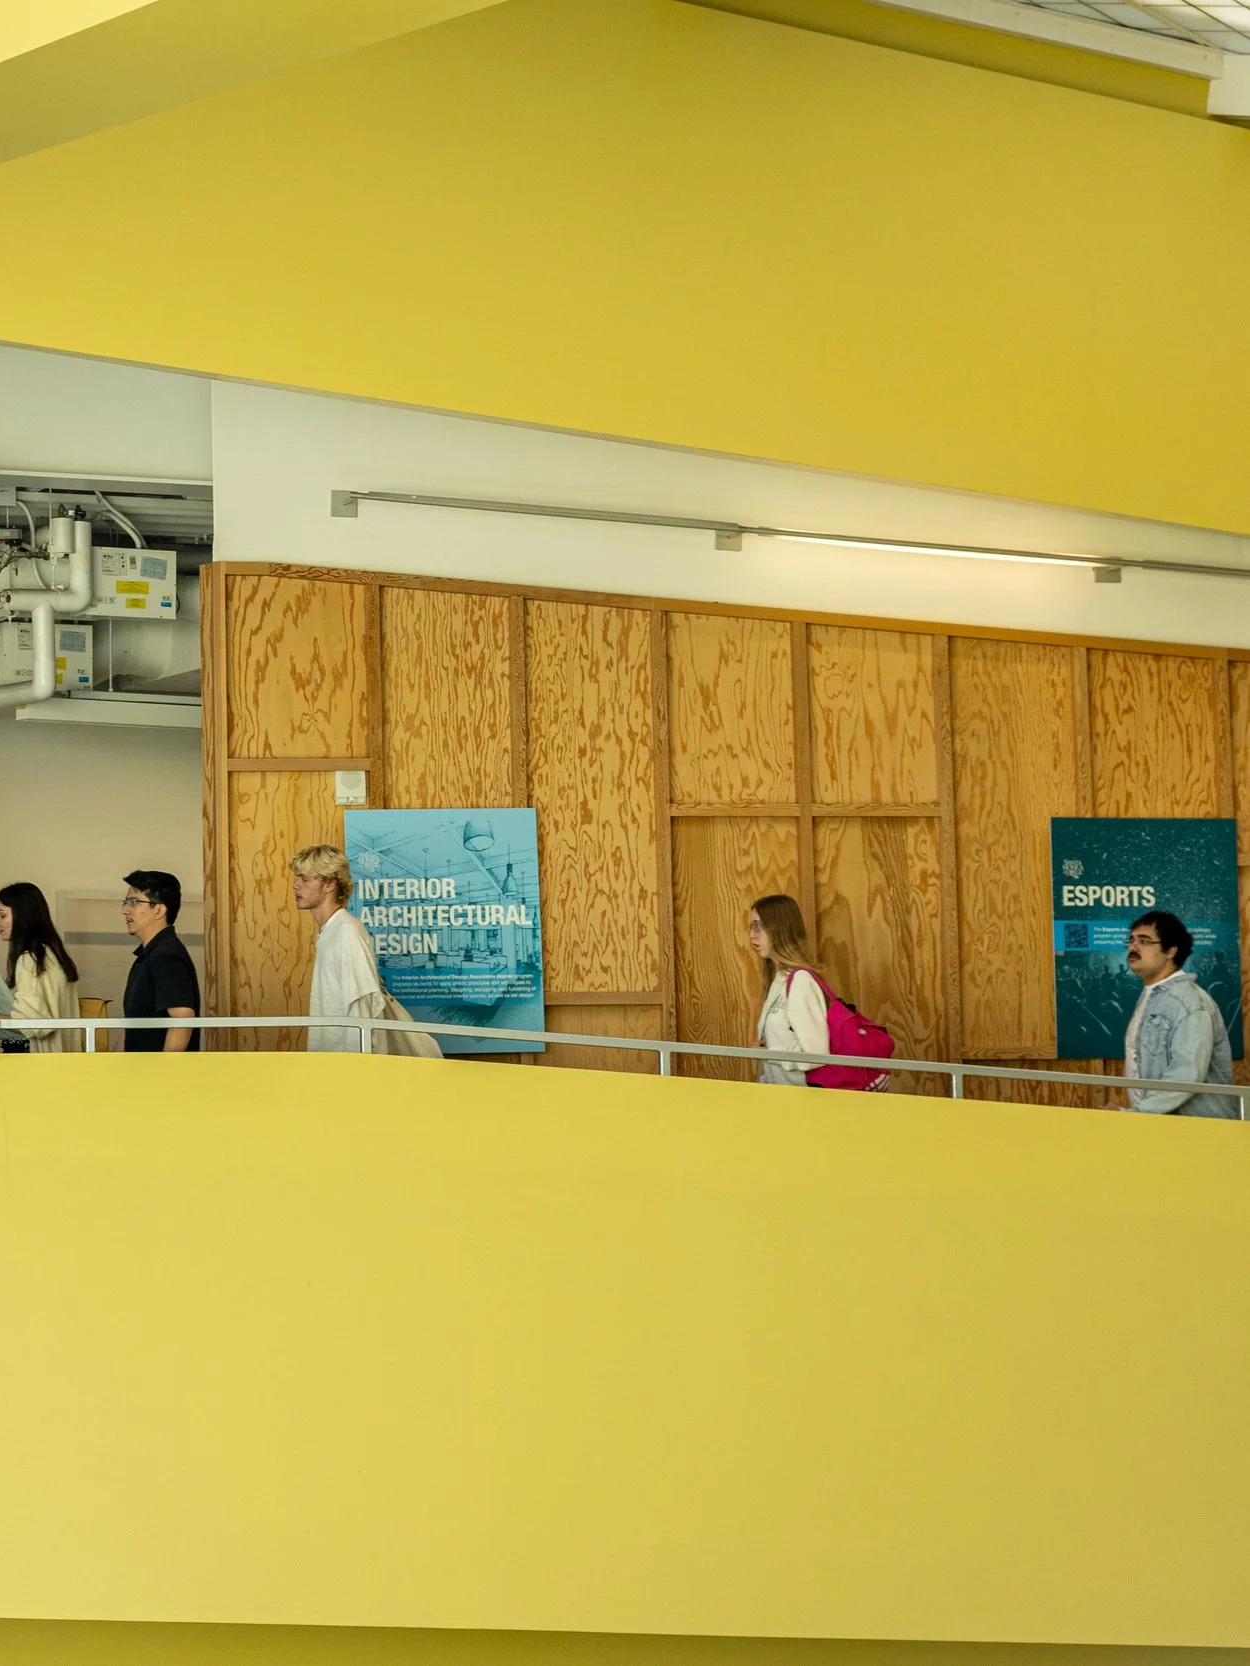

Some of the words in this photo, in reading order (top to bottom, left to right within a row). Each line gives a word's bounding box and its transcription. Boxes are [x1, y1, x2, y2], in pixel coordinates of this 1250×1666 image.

[358, 878, 456, 899] INTERIOR
[1062, 885, 1156, 907] ESPORTS
[359, 904, 533, 927] ARCHITECTURAL
[375, 933, 438, 955] ESIGN
